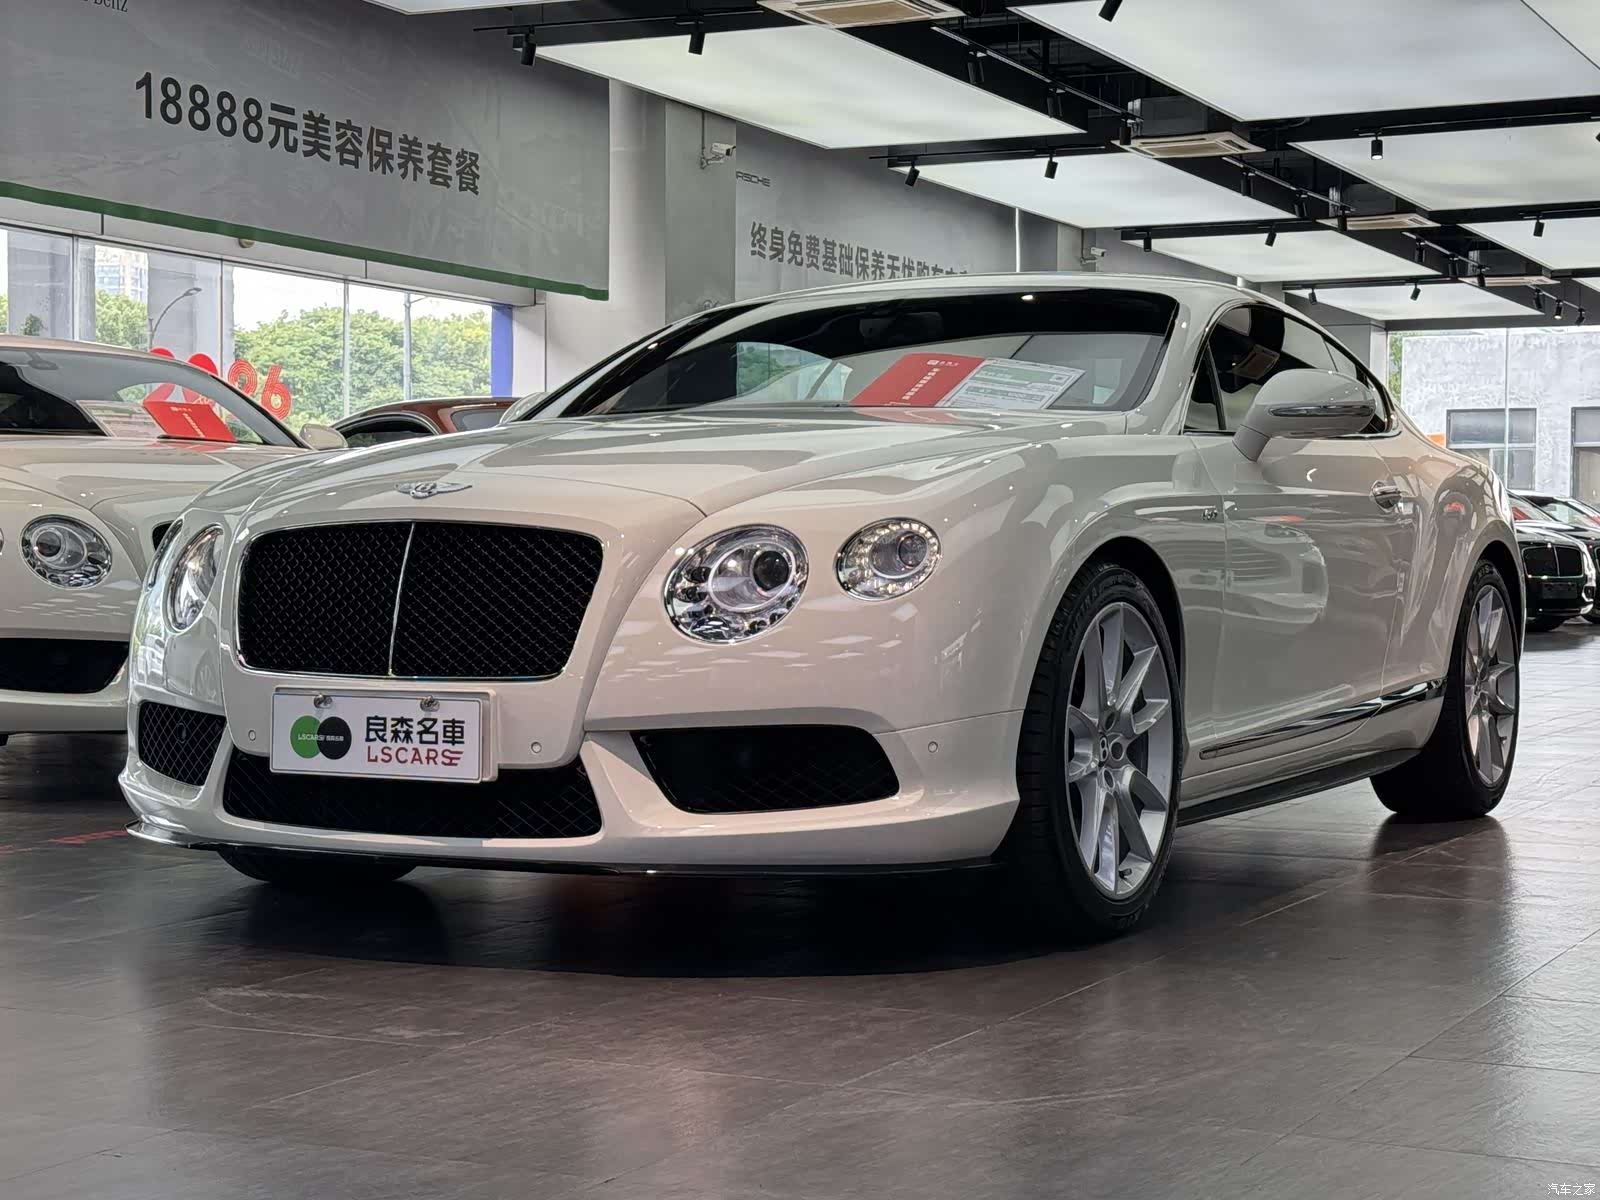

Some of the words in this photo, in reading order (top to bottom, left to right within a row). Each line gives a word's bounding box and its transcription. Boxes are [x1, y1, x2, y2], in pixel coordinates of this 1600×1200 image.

[135, 71, 480, 195] 18888元美容保养套餐
[365, 715, 466, 746] 良森名車
[367, 745, 464, 767] LSCARS
